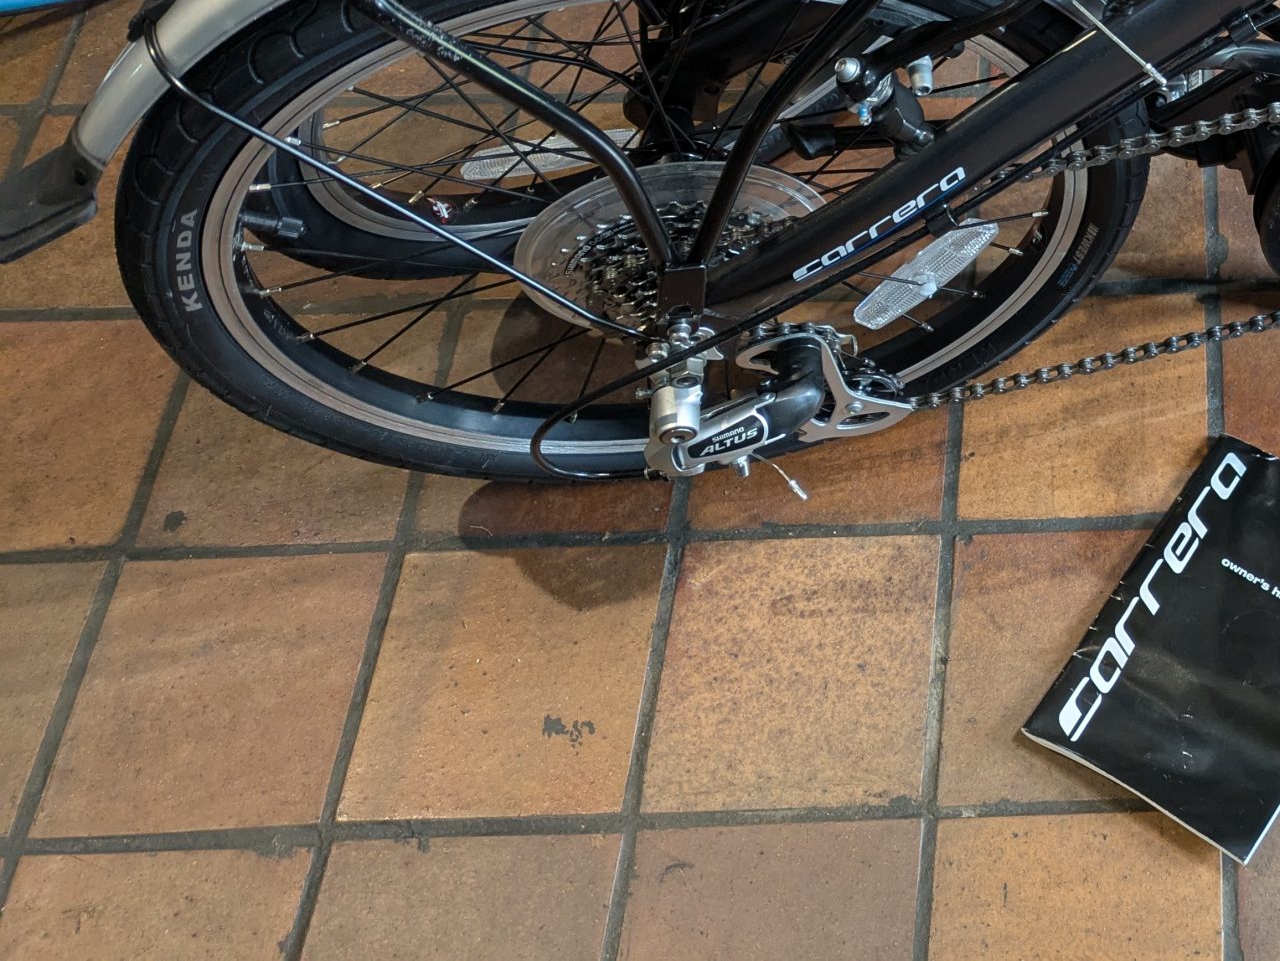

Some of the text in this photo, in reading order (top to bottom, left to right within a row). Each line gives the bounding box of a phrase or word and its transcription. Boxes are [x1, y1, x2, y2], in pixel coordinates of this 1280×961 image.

[792, 166, 967, 282] carrera
[175, 208, 203, 312] KENDA
[699, 427, 758, 457] ALTUS
[711, 426, 745, 443] SHIMANO
[1058, 452, 1249, 742] carrera
[1220, 557, 1271, 592] owner's
